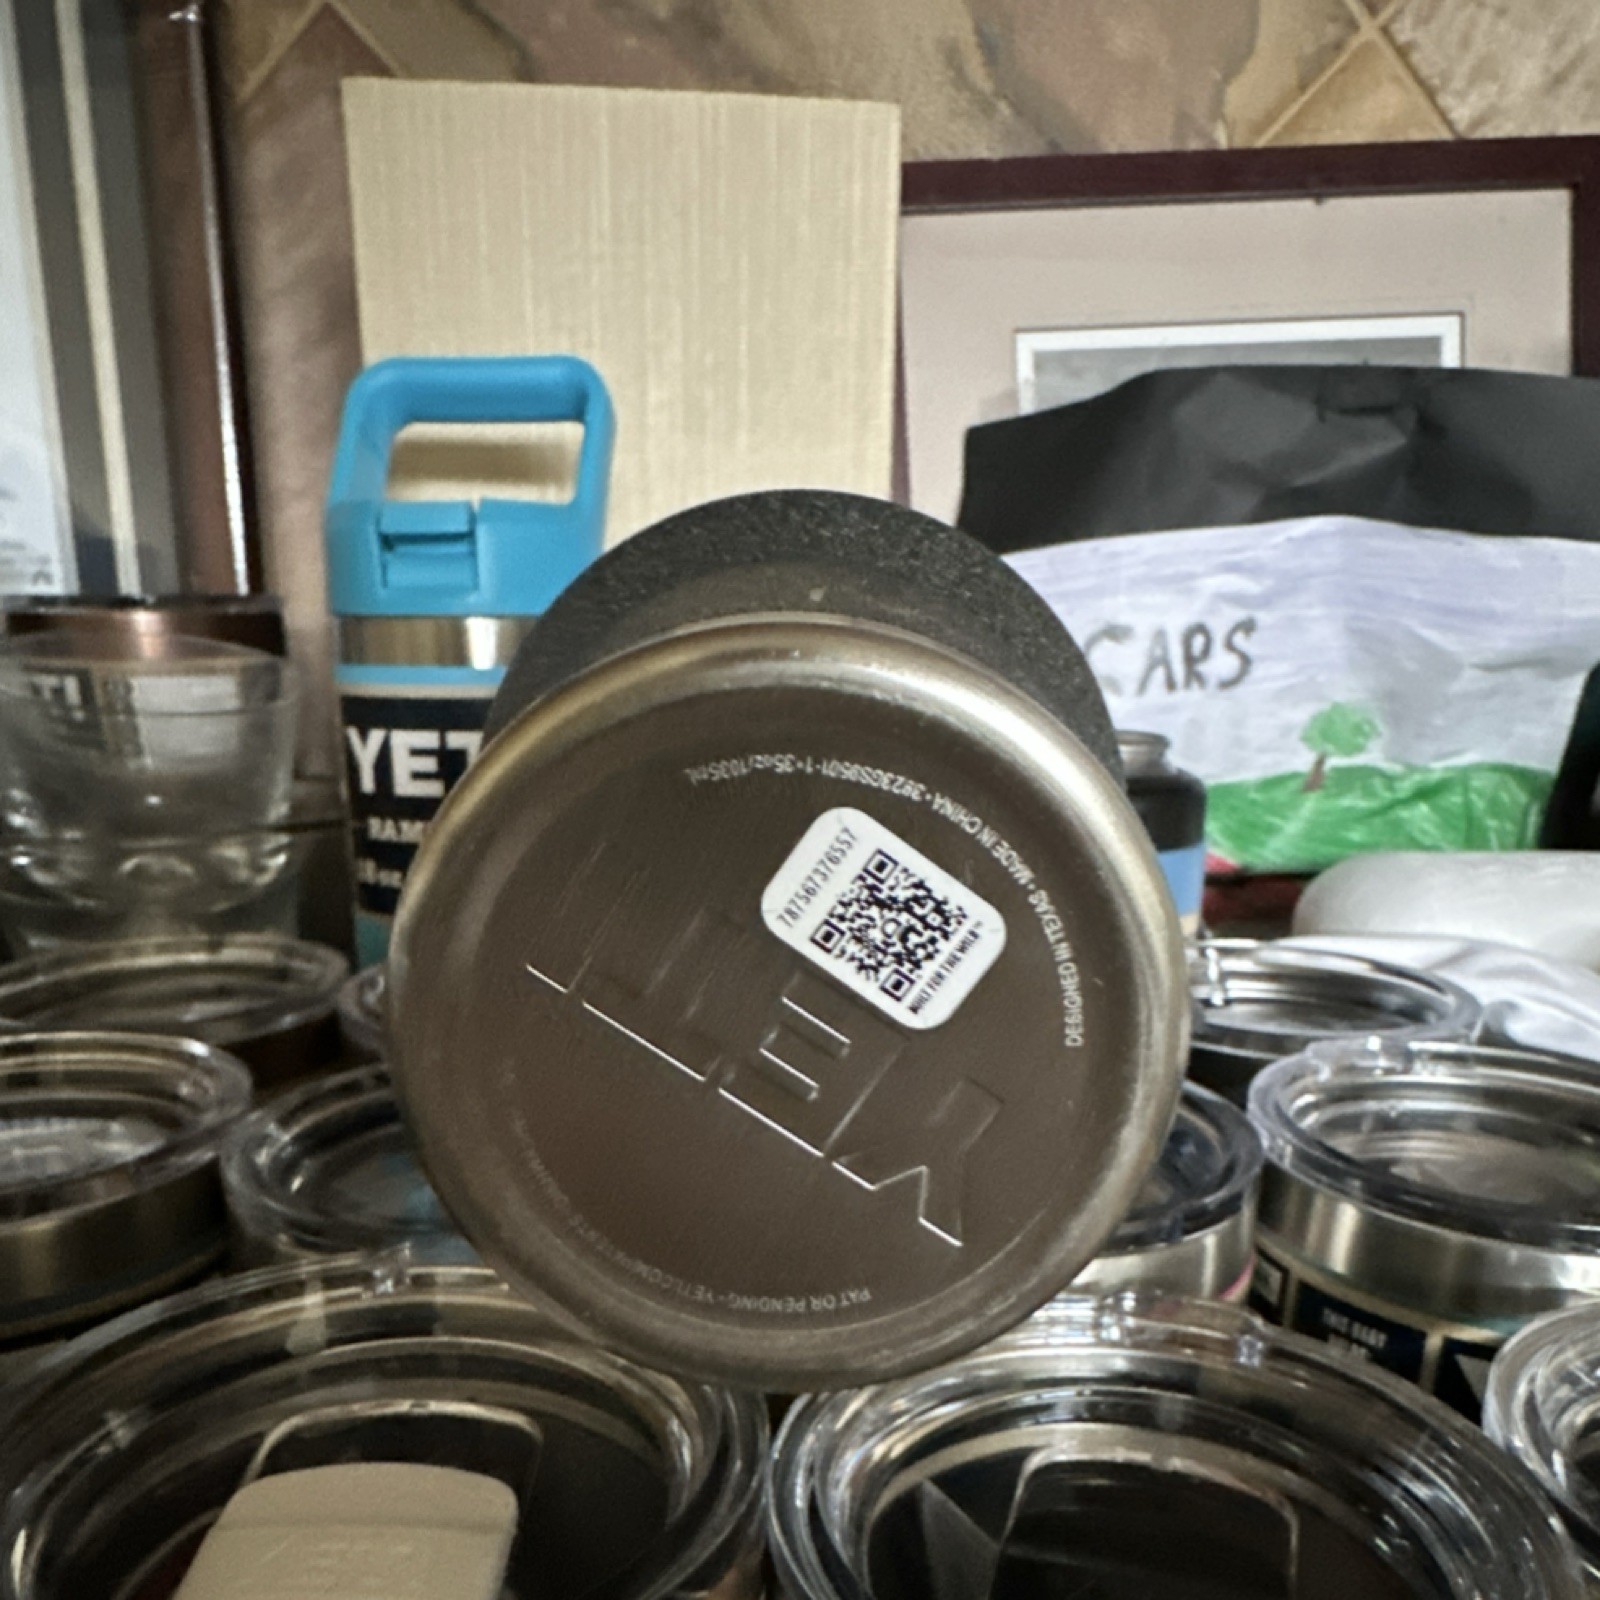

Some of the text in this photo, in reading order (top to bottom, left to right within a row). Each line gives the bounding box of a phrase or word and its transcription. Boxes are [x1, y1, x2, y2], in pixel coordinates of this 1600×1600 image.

[1084, 616, 1257, 696] CARS
[932, 791, 984, 835] CHINA
[976, 824, 1001, 850] IN
[775, 826, 859, 928] 787567376557
[992, 838, 1036, 886] MADE
[1028, 888, 1066, 942] TEXAS
[925, 970, 946, 992] FOR
[939, 952, 962, 974] THE
[1052, 941, 1074, 962] IN
[1058, 961, 1085, 1047] DESIGNED
[727, 1290, 807, 1313] PENDING
[810, 1293, 837, 1311] OR
[839, 1287, 872, 1307] PAT
